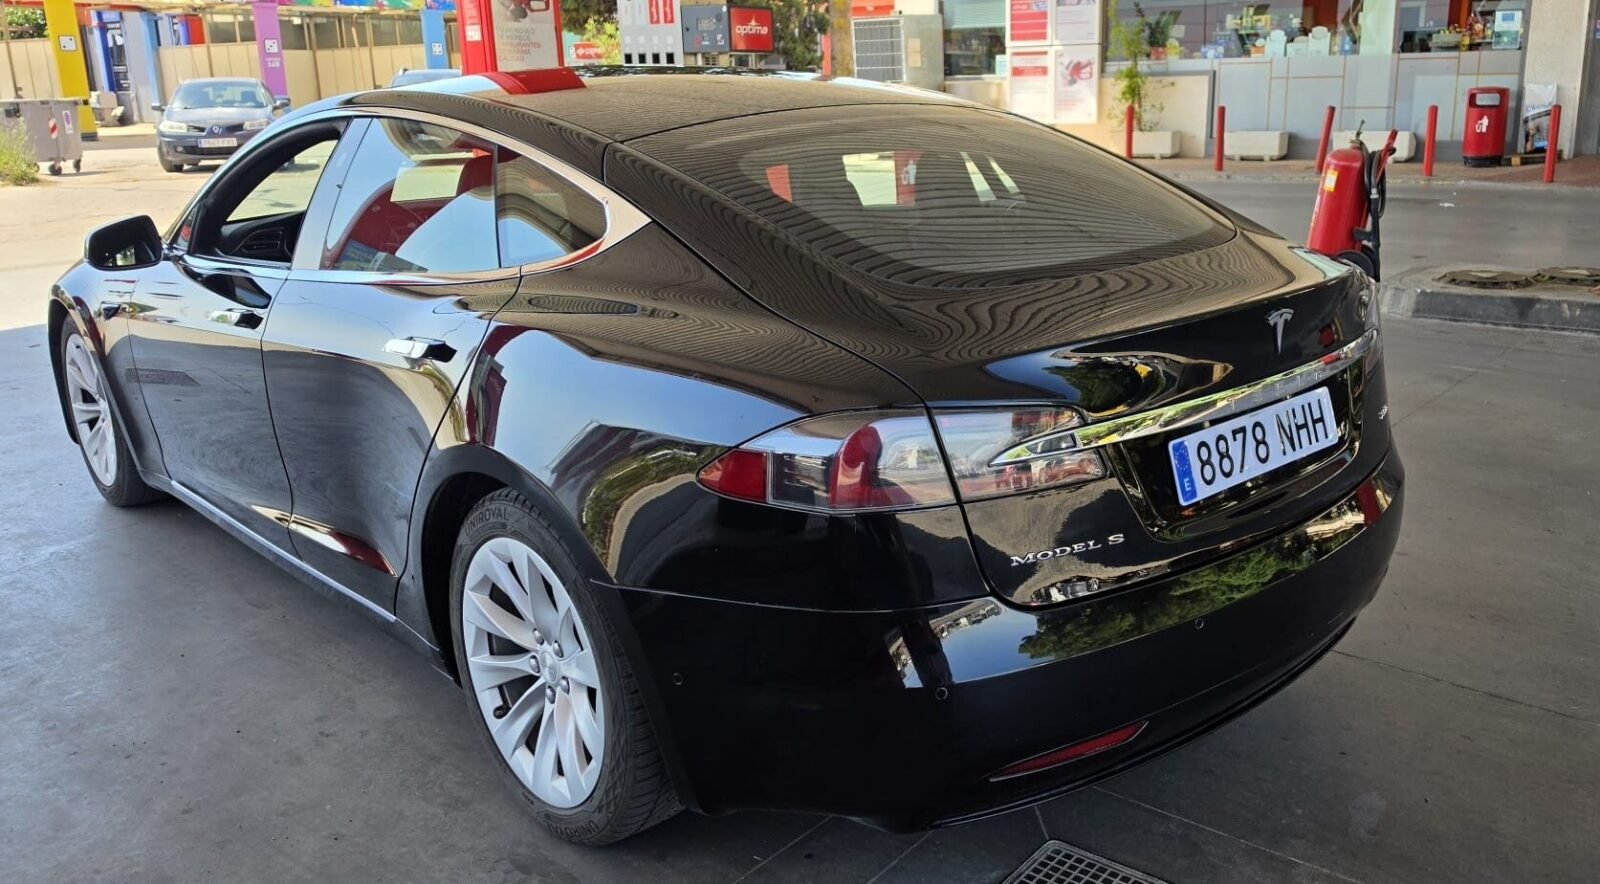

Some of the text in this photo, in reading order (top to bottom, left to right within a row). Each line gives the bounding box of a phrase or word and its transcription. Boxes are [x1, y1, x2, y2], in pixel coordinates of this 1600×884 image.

[735, 24, 768, 36] optima
[1184, 398, 1330, 491] E 8878 NHH
[464, 507, 509, 536] UNIROYAL
[1010, 532, 1126, 567] MODEL S
